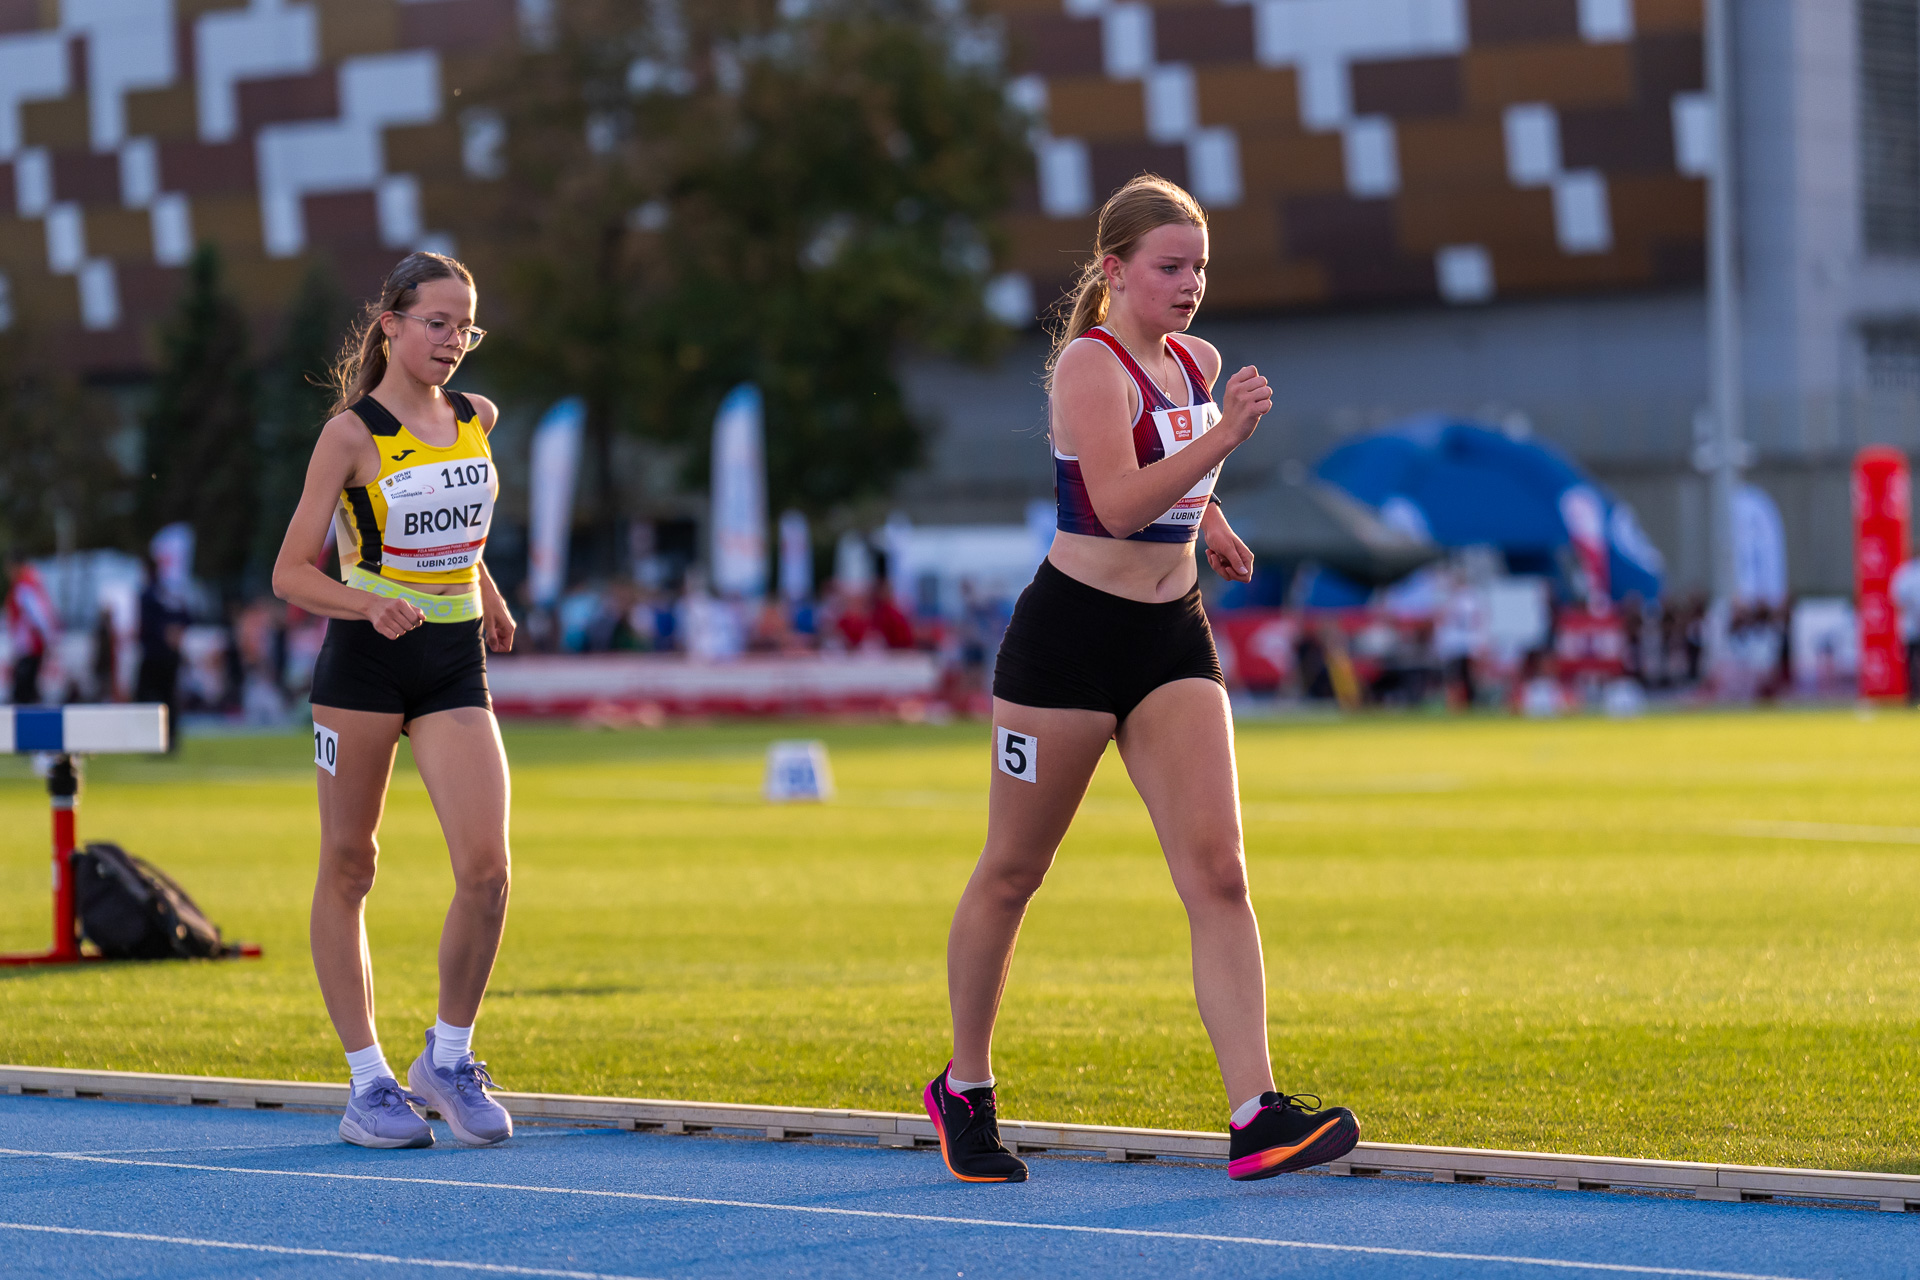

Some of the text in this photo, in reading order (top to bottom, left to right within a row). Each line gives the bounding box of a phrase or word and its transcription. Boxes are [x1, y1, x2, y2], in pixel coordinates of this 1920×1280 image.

[440, 464, 489, 489] 1107
[403, 503, 483, 536] BRONZ
[1171, 511, 1195, 520] LUBIN
[416, 555, 469, 568] LUBIN 2026
[314, 731, 336, 767] 10
[1004, 733, 1027, 775] 5
